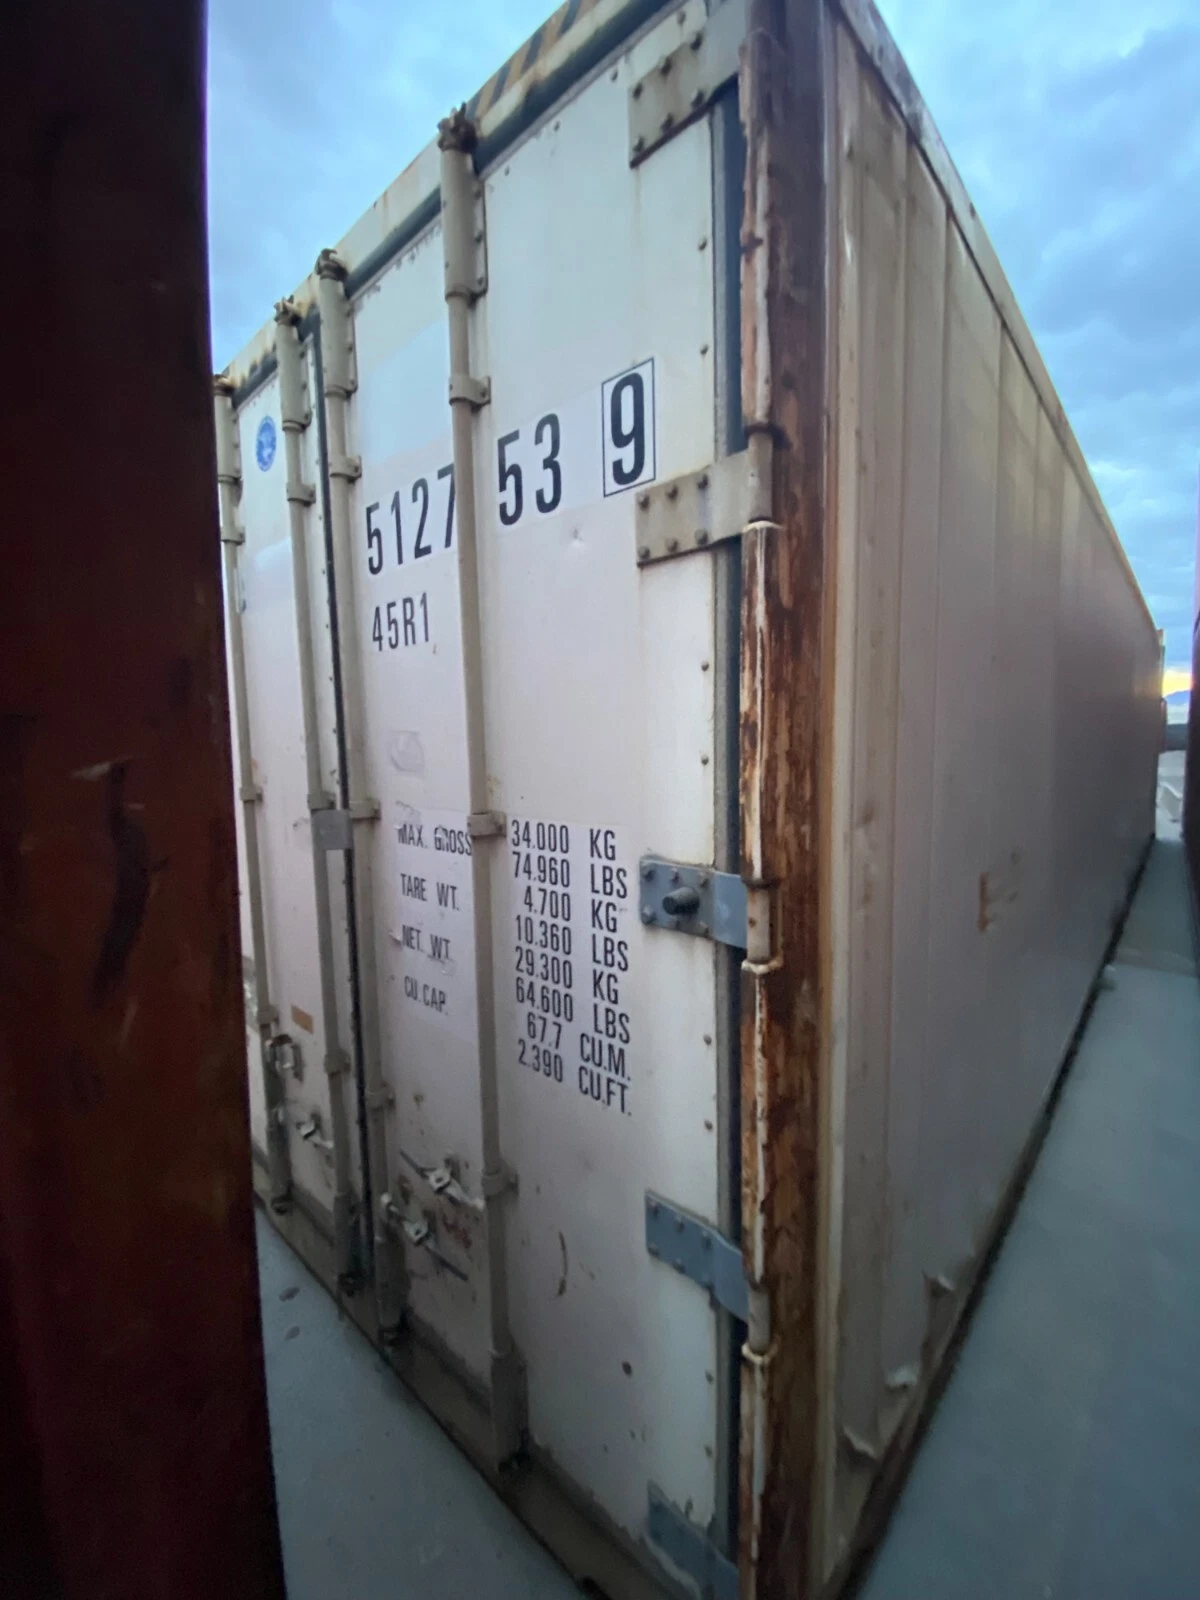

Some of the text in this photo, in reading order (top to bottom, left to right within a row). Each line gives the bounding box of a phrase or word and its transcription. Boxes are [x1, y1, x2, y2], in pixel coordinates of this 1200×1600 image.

[366, 372, 645, 575] 5127 53 9
[372, 592, 429, 652] 45R1
[512, 820, 569, 854] 34.000
[590, 828, 616, 861] KG
[401, 874, 617, 933] TARE WT. 4.700 KG
[512, 852, 627, 899] 74.960 LBS
[516, 915, 629, 972] 10.360 LBS
[515, 946, 572, 989] 29.300
[593, 968, 619, 1005] KG
[516, 977, 630, 1044] 64.600 LBS
[527, 1012, 562, 1049] 67.7
[518, 1039, 563, 1083] 2.390
